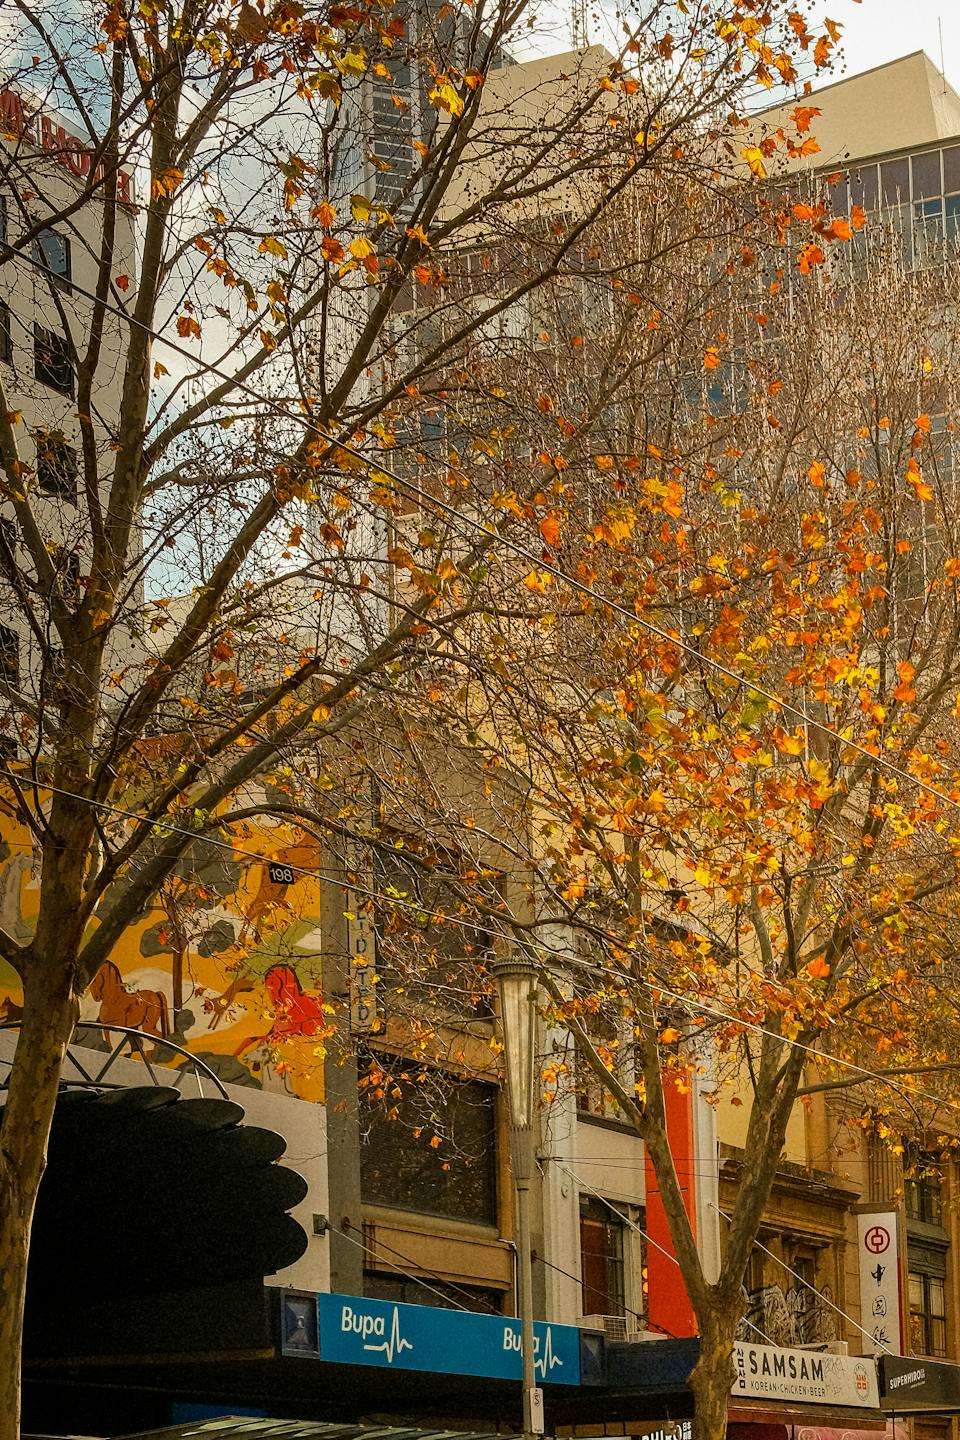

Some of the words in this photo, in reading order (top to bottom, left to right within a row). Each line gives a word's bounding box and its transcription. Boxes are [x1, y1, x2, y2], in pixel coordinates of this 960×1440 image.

[270, 868, 293, 882] 198
[342, 1306, 385, 1340] Bupa
[503, 1327, 541, 1358] Bua
[749, 1350, 824, 1382] SAMSAM
[750, 1381, 778, 1394] KOREAN
[780, 1384, 808, 1397] CHICKEN
[810, 1388, 826, 1398] BEER
[889, 1370, 921, 1390] SUPERHIRO
